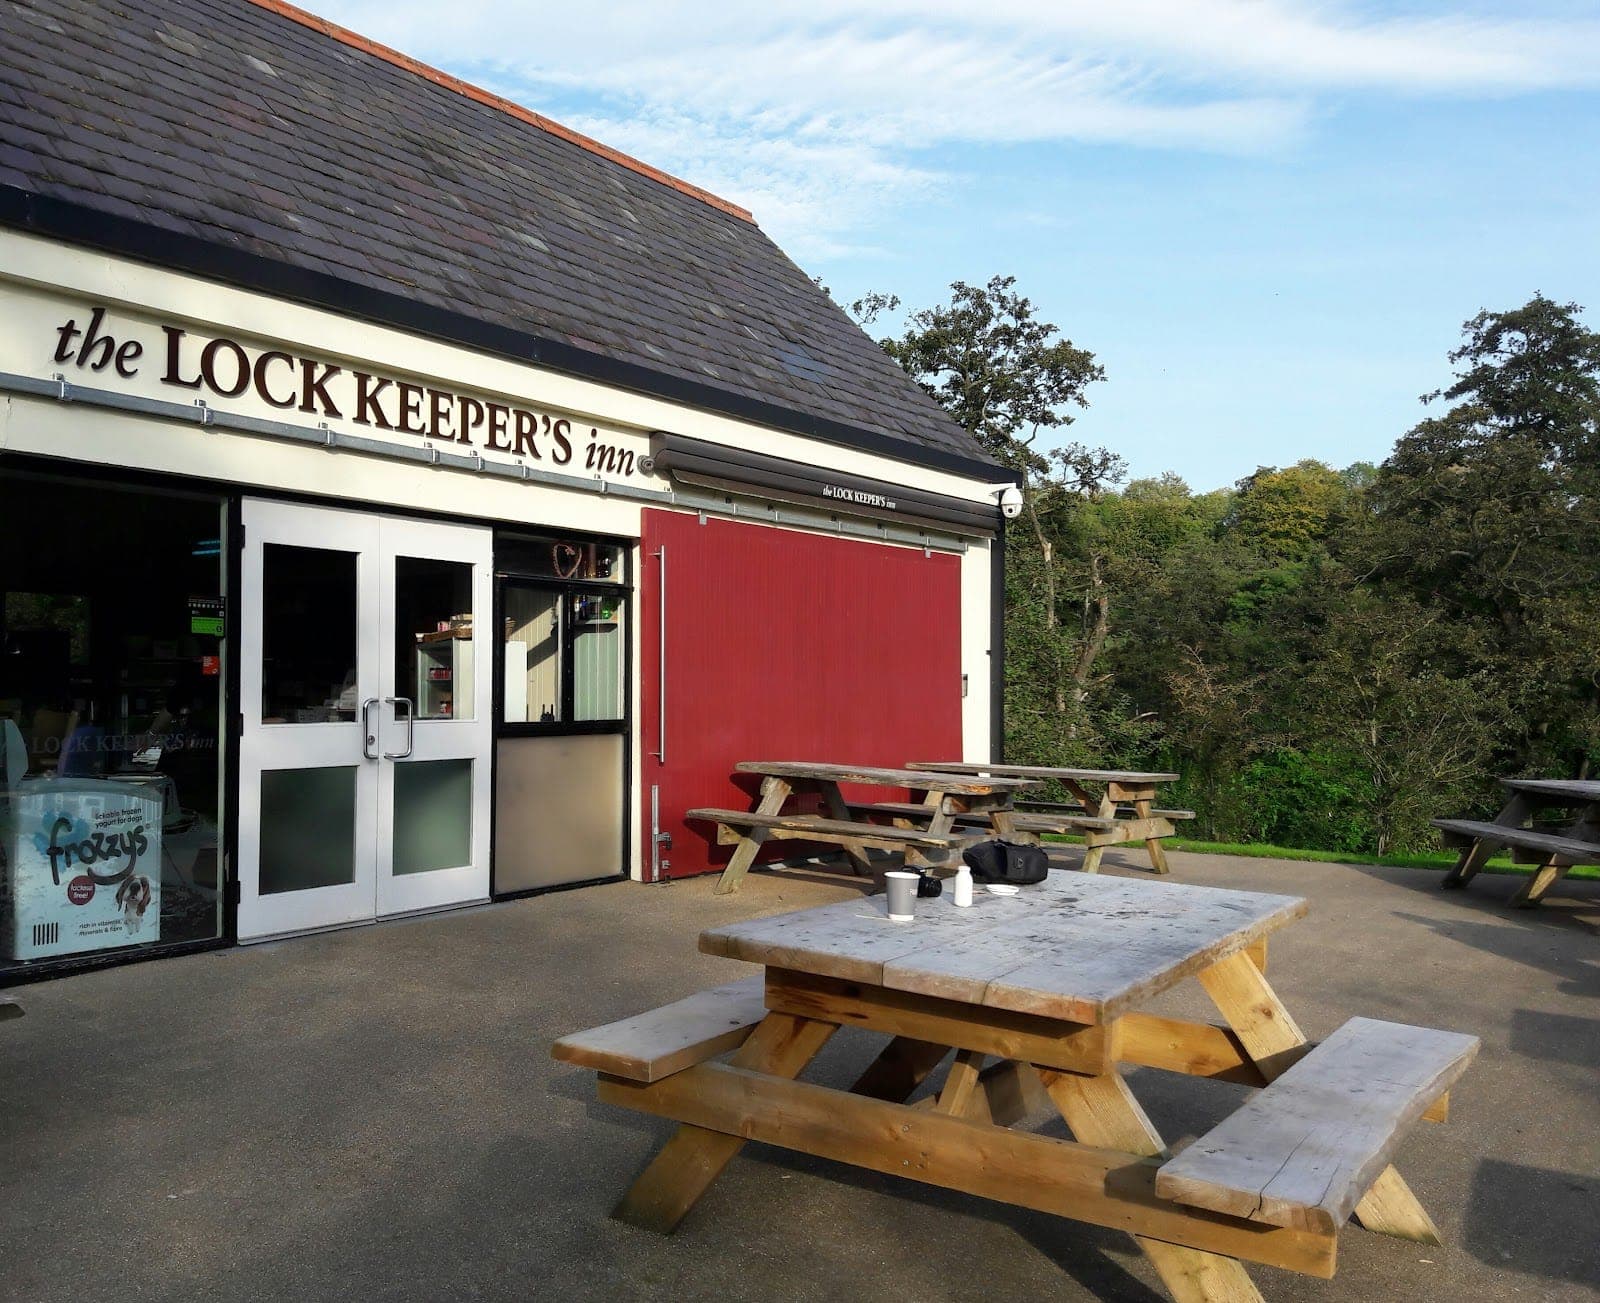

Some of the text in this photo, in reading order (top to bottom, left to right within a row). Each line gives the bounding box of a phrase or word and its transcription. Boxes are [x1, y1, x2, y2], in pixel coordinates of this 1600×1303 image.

[55, 308, 638, 478] the LOCK KEEPER'S inn
[833, 487, 853, 501] LOCK
[854, 491, 885, 508] KEEPER'S
[117, 817, 126, 825] for
[127, 814, 143, 824] dogs
[121, 807, 142, 816] frozen
[47, 816, 148, 885] frozzys
